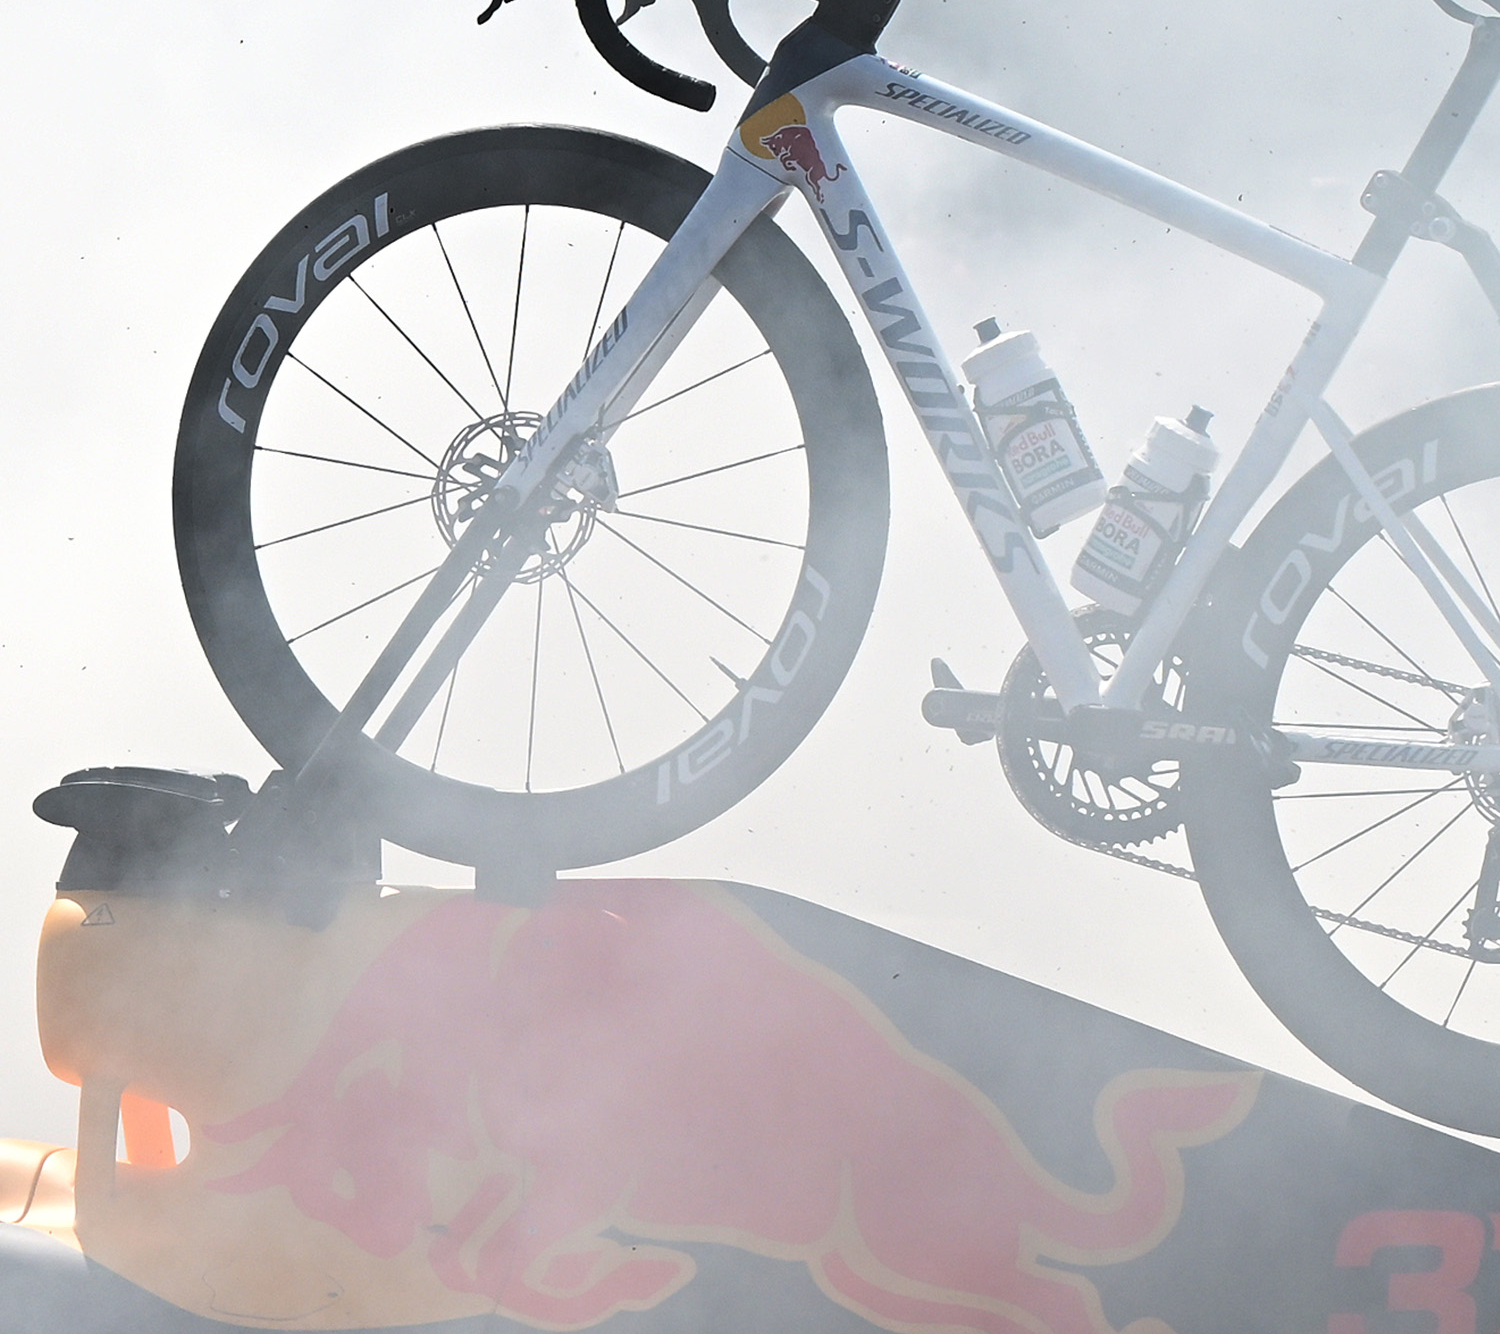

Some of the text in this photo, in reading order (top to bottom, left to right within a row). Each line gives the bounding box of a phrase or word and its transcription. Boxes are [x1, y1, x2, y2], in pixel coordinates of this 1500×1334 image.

[875, 82, 1032, 145] SPECIALIZED
[217, 191, 390, 434] roval
[820, 207, 1040, 575] S-WORKS
[1029, 423, 1057, 447] Bull
[1012, 439, 1065, 474] BORA
[1031, 478, 1075, 505] GARMIN
[1095, 516, 1141, 556] BORA
[1123, 513, 1152, 542] Bull
[1242, 437, 1440, 668] roval
[656, 564, 831, 806] roval
[1322, 740, 1479, 767] SPECIALIZED
